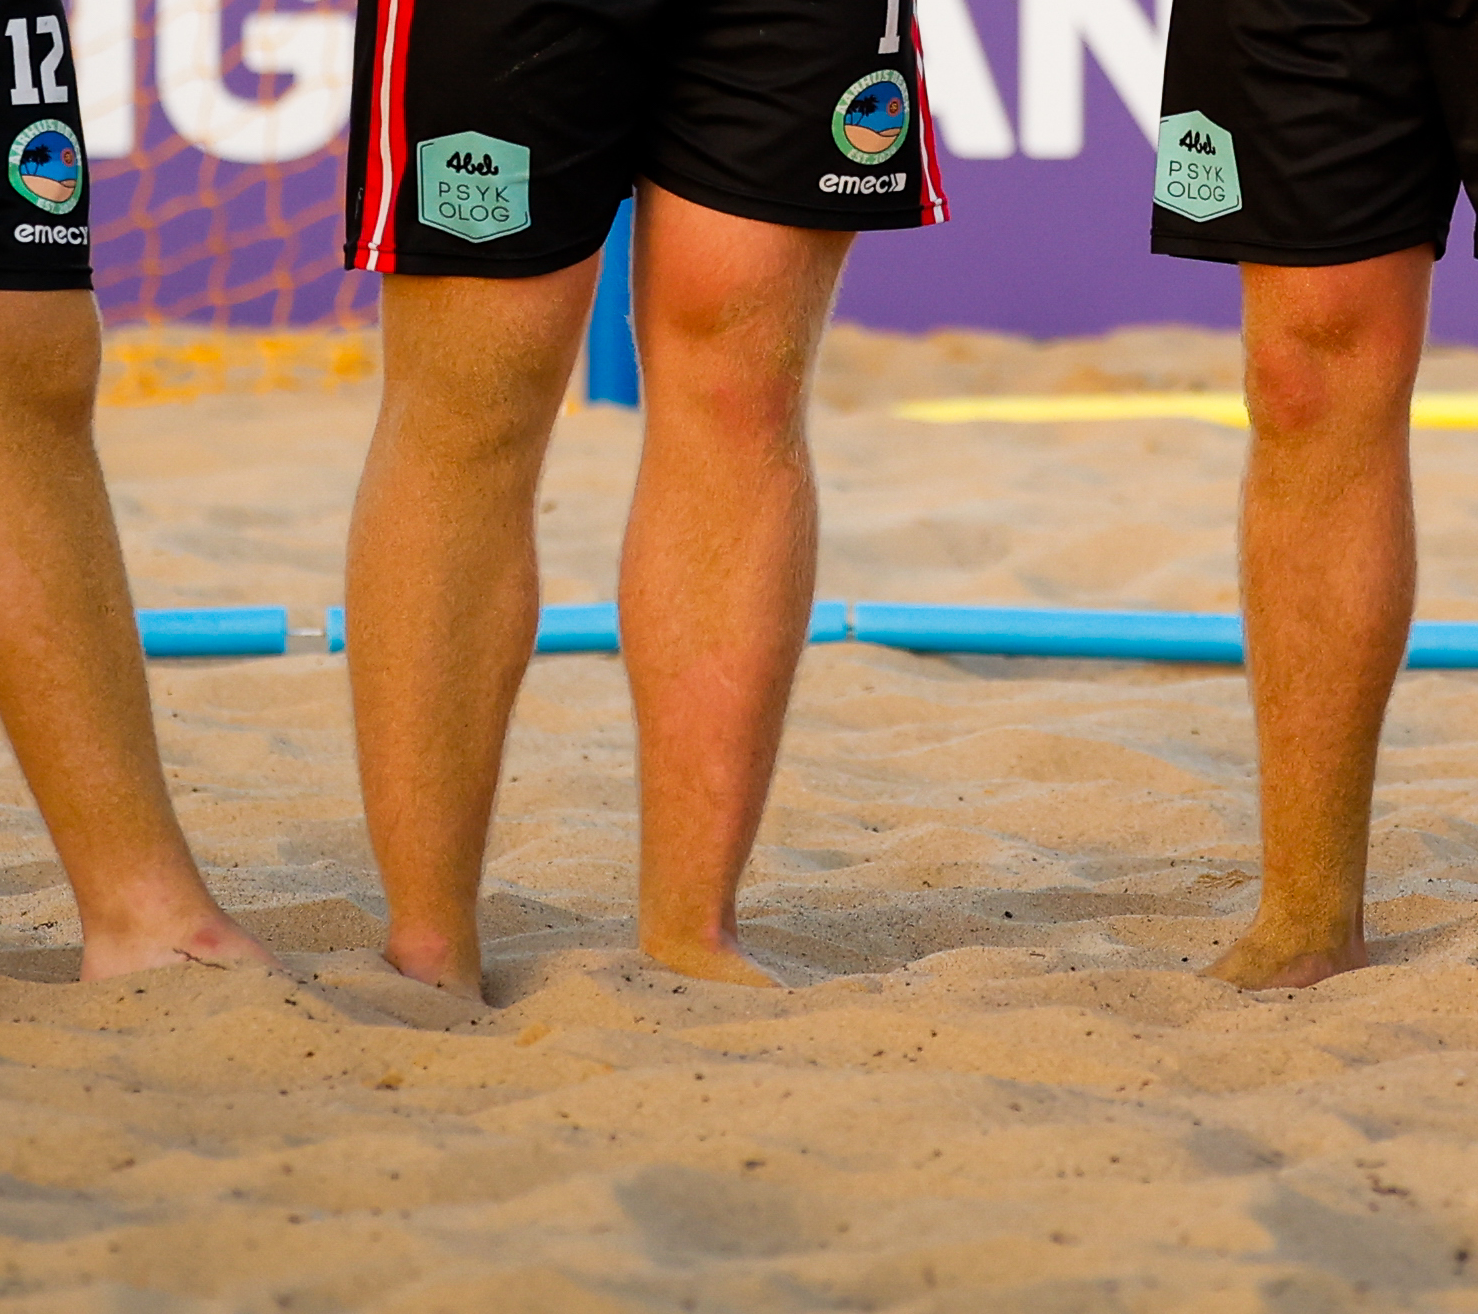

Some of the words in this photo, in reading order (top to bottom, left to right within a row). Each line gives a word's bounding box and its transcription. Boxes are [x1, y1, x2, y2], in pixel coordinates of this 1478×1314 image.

[4, 14, 69, 106] 12
[1169, 159, 1225, 184] PSYK
[438, 181, 510, 203] PSYK
[818, 173, 890, 195] emec
[1167, 180, 1226, 203] OLOG
[438, 201, 510, 223] OLOG
